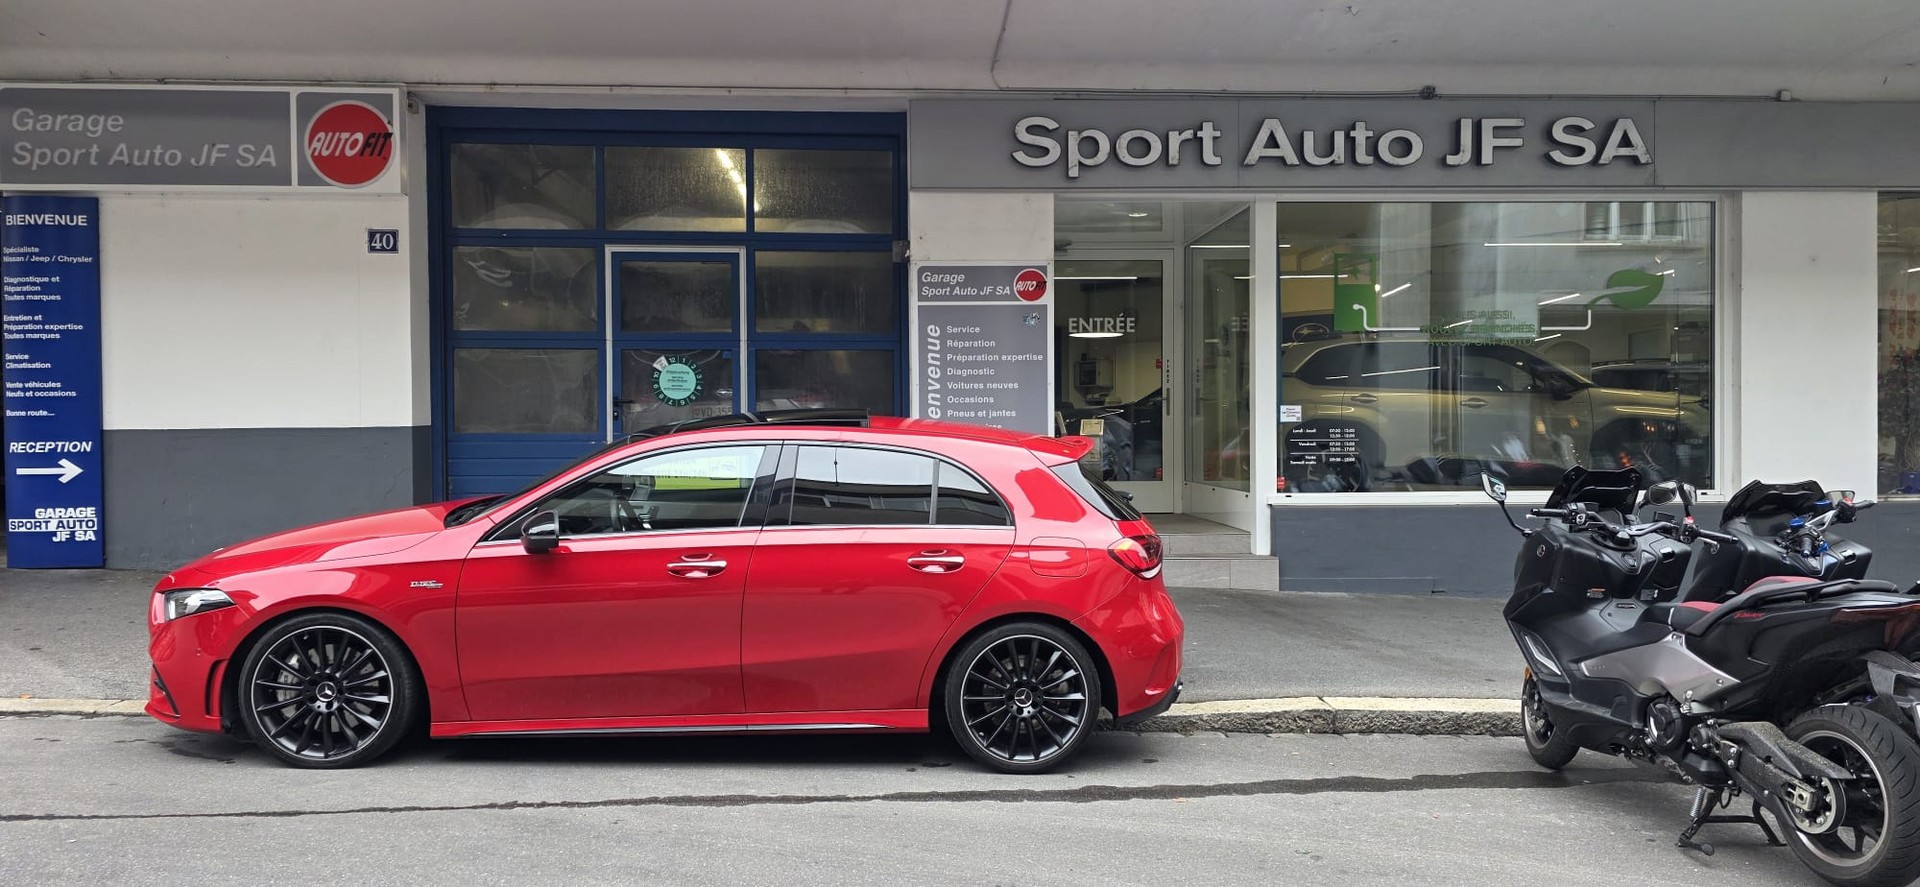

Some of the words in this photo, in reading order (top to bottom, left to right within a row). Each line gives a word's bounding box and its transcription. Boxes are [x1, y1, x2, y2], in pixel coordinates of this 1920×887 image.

[11, 108, 125, 137] Garage
[309, 131, 394, 158] AUTOFIT
[1011, 115, 1223, 178] Sport
[1242, 117, 1425, 168] Auto
[1445, 117, 1526, 167] JF
[1545, 117, 1654, 168] SA
[11, 142, 100, 170] Sport
[108, 143, 182, 167] Auto
[190, 143, 229, 168] JF
[235, 144, 277, 168] SA
[6, 214, 88, 226] BIENVENUE
[371, 232, 394, 250] 40
[3, 246, 40, 254] Spécialiste
[3, 255, 24, 263] Nissan
[30, 255, 50, 264] Jeep
[57, 255, 93, 264] Chrysler
[4, 276, 49, 284] Diagnostique
[921, 272, 965, 284] Garage
[4, 285, 41, 293] Réparation
[921, 286, 950, 298] Sport
[952, 286, 977, 296] Auto
[980, 286, 994, 296] JF
[995, 286, 1011, 296] SA
[4, 323, 43, 331] Préparation
[1068, 312, 1136, 333] ENTRÉE
[946, 325, 981, 333] Service
[947, 339, 996, 349] Réparation
[947, 353, 999, 363] Préparation
[1001, 353, 1043, 363] expertise
[927, 324, 941, 419] envenue
[947, 367, 995, 377] Diagnostic
[947, 381, 984, 389] Voitures
[947, 395, 994, 403] Occasions
[947, 409, 975, 417] Pneus
[988, 409, 1016, 418] jantes
[9, 441, 92, 453] RECEPTION
[35, 507, 96, 519] GARAGE
[10, 520, 51, 531] SPORT
[56, 519, 96, 530] AUTO
[52, 531, 70, 542] JF
[75, 530, 96, 541] SA
